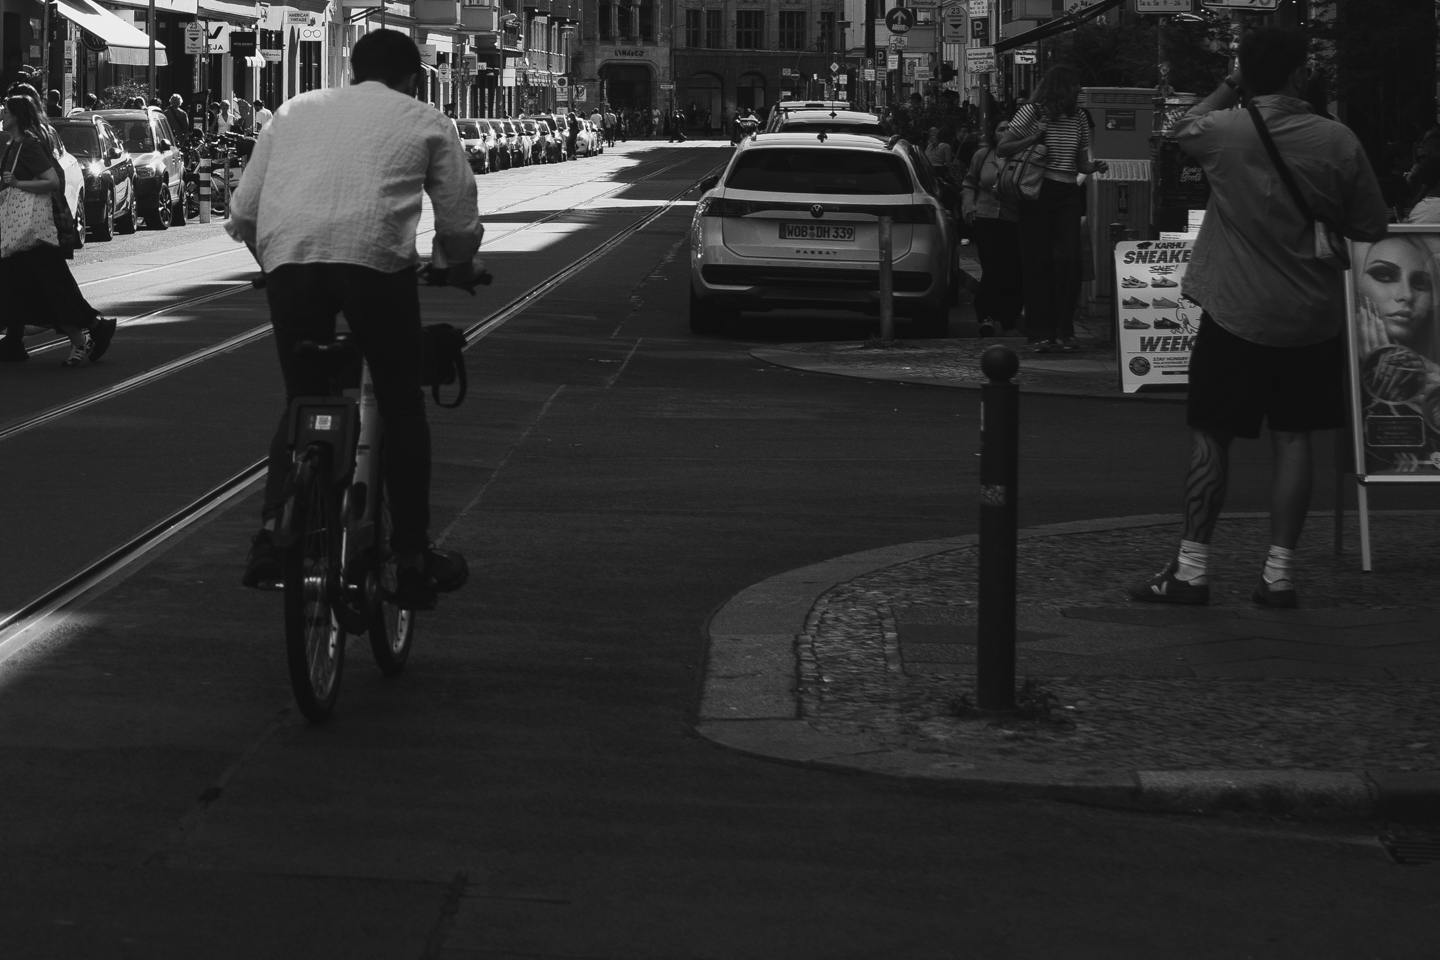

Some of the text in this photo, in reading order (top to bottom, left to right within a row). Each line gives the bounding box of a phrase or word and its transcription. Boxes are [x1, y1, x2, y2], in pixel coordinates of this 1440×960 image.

[208, 43, 224, 51] EJA
[787, 225, 854, 240] WOB DH 339
[1155, 241, 1188, 250] KARHU
[1122, 249, 1193, 265] SNEAKE
[1139, 335, 1195, 352] WEEK
